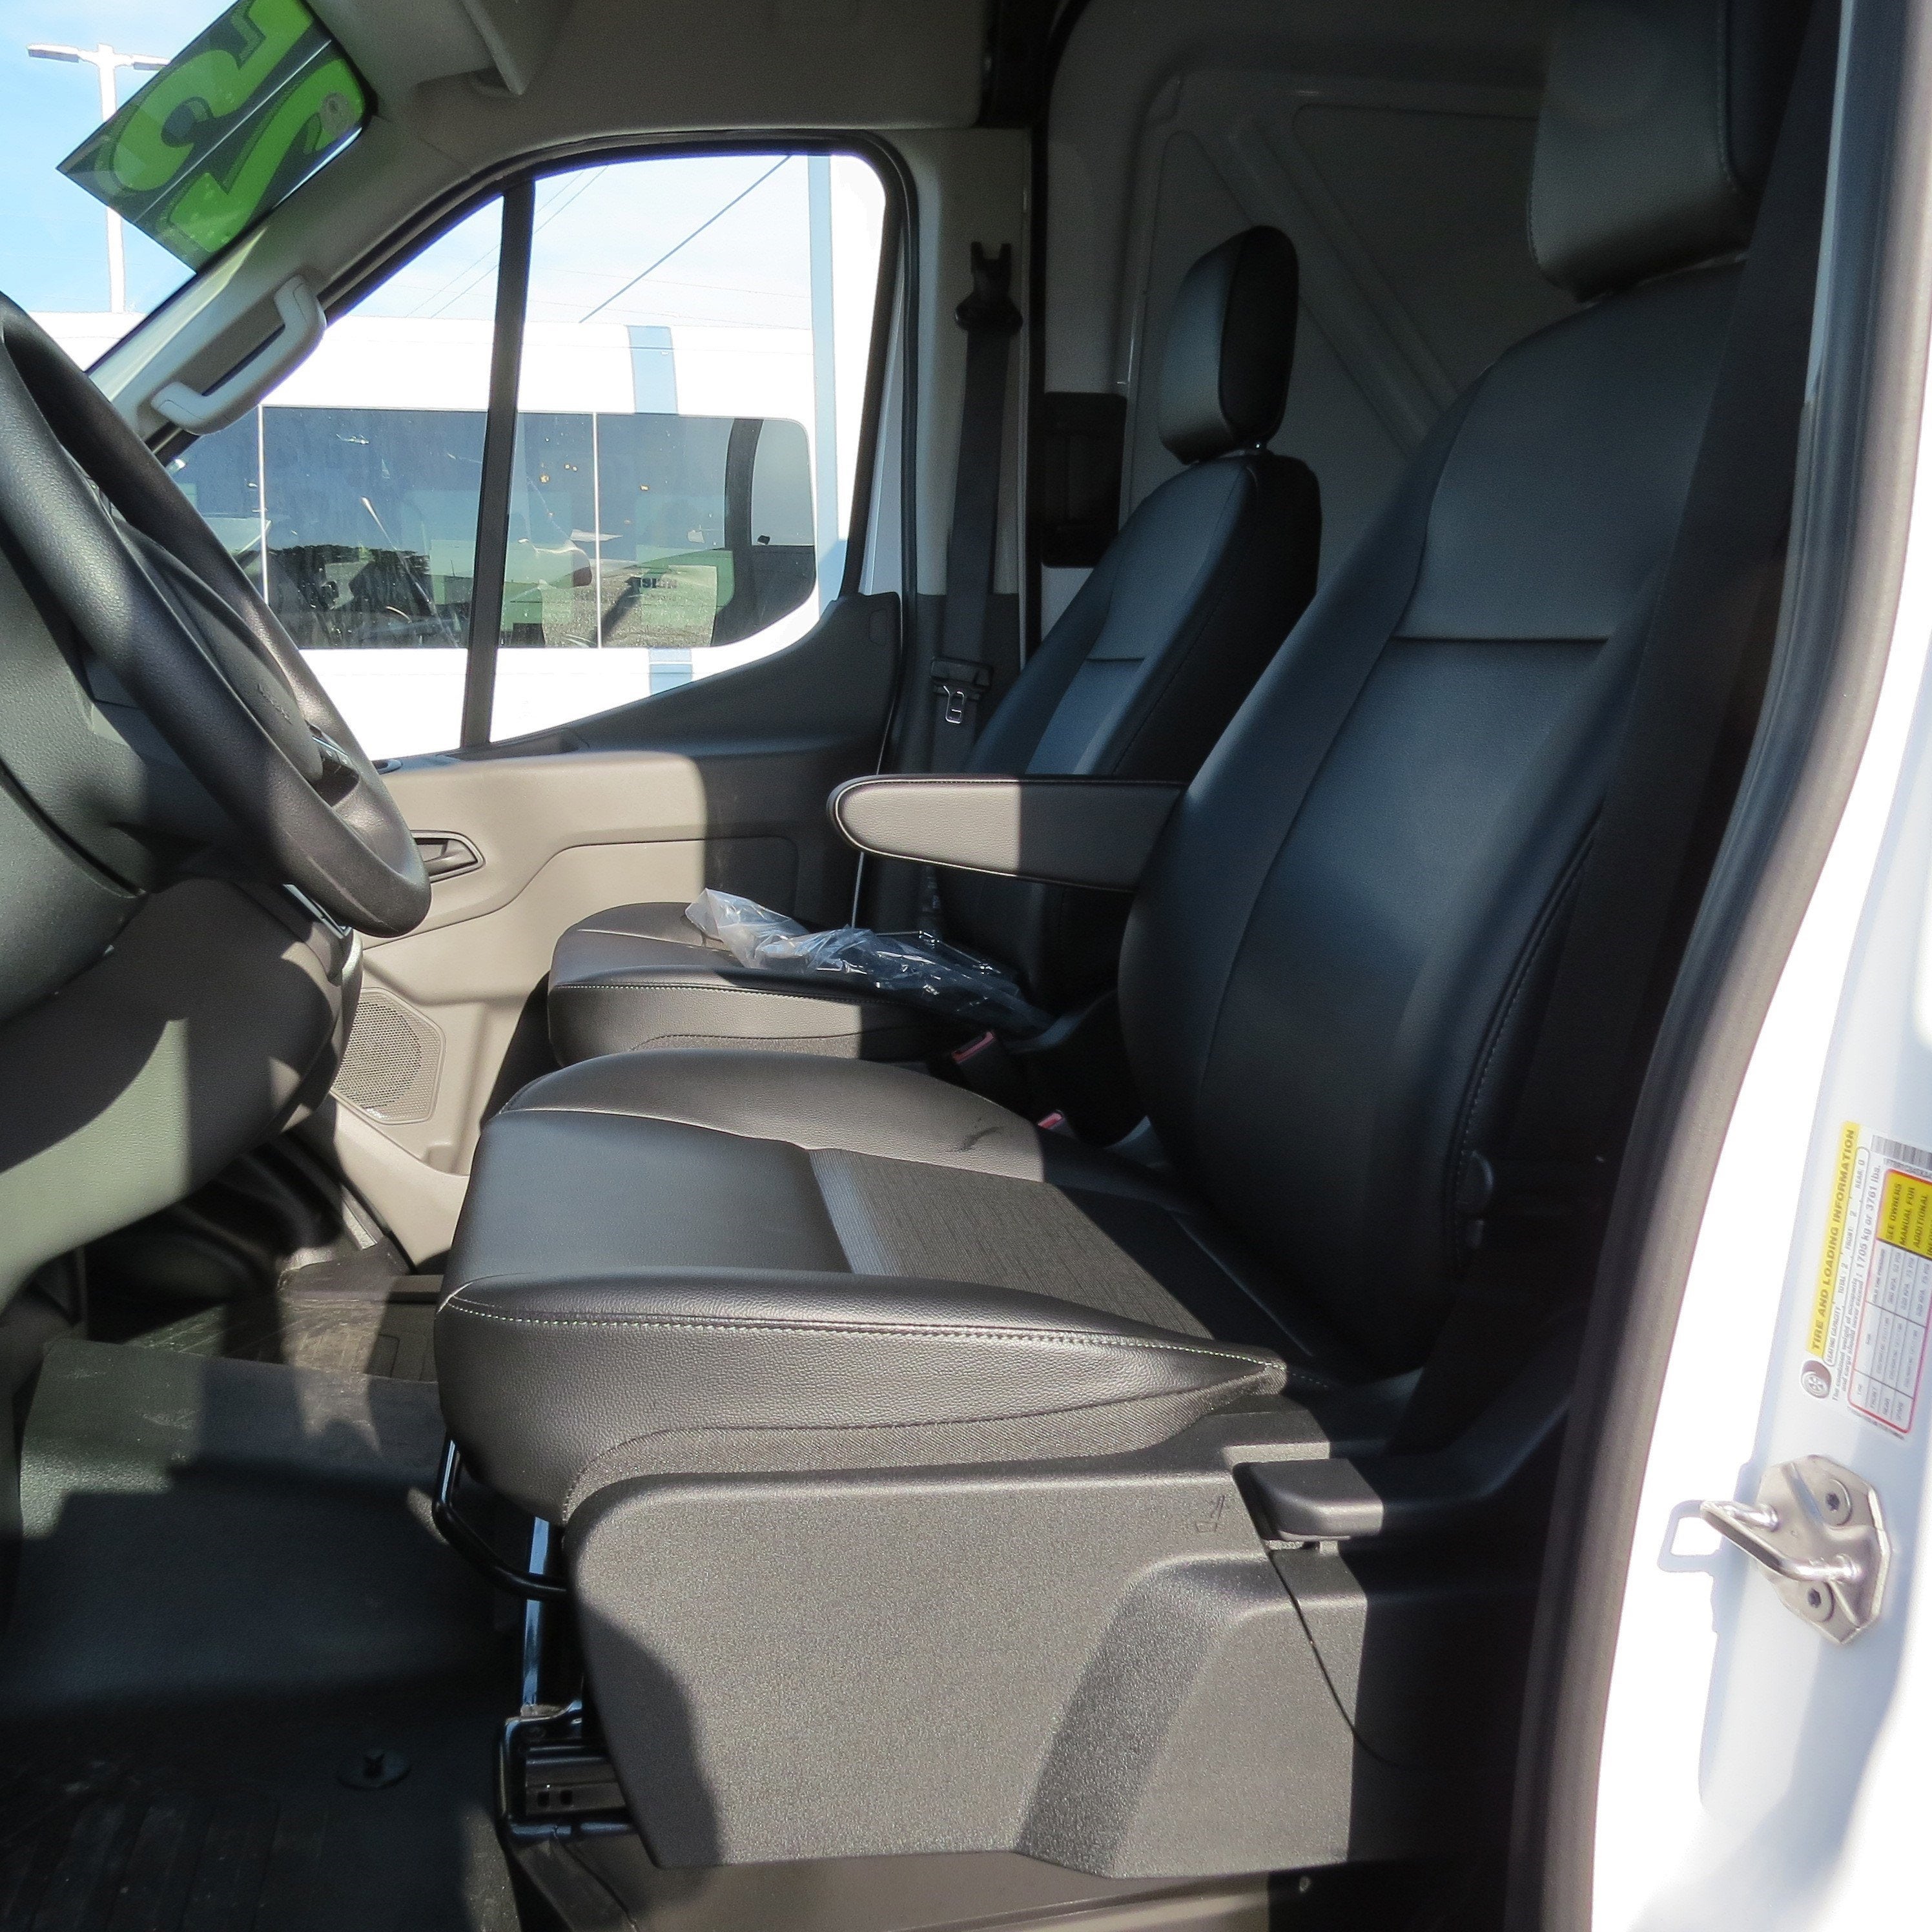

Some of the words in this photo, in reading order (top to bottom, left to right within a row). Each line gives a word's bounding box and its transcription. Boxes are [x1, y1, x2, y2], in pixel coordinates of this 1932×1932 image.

[1831, 1129, 1855, 1223] INFORMATION
[1869, 1165, 1880, 1183] lbs.
[1865, 1186, 1877, 1211] 3761
[1864, 1215, 1873, 1226] or
[1898, 1208, 1911, 1246] MANUAL
[1905, 1186, 1915, 1206] FOR
[1912, 1193, 1929, 1249] ADDITIONAL
[1860, 1227, 1871, 1242] kg
[1885, 1223, 1895, 1241] SEE
[1822, 1226, 1839, 1286] LOADING
[1855, 1242, 1868, 1269] 1705
[1816, 1288, 1829, 1317] AND
[1811, 1320, 1824, 1351] TIRE
